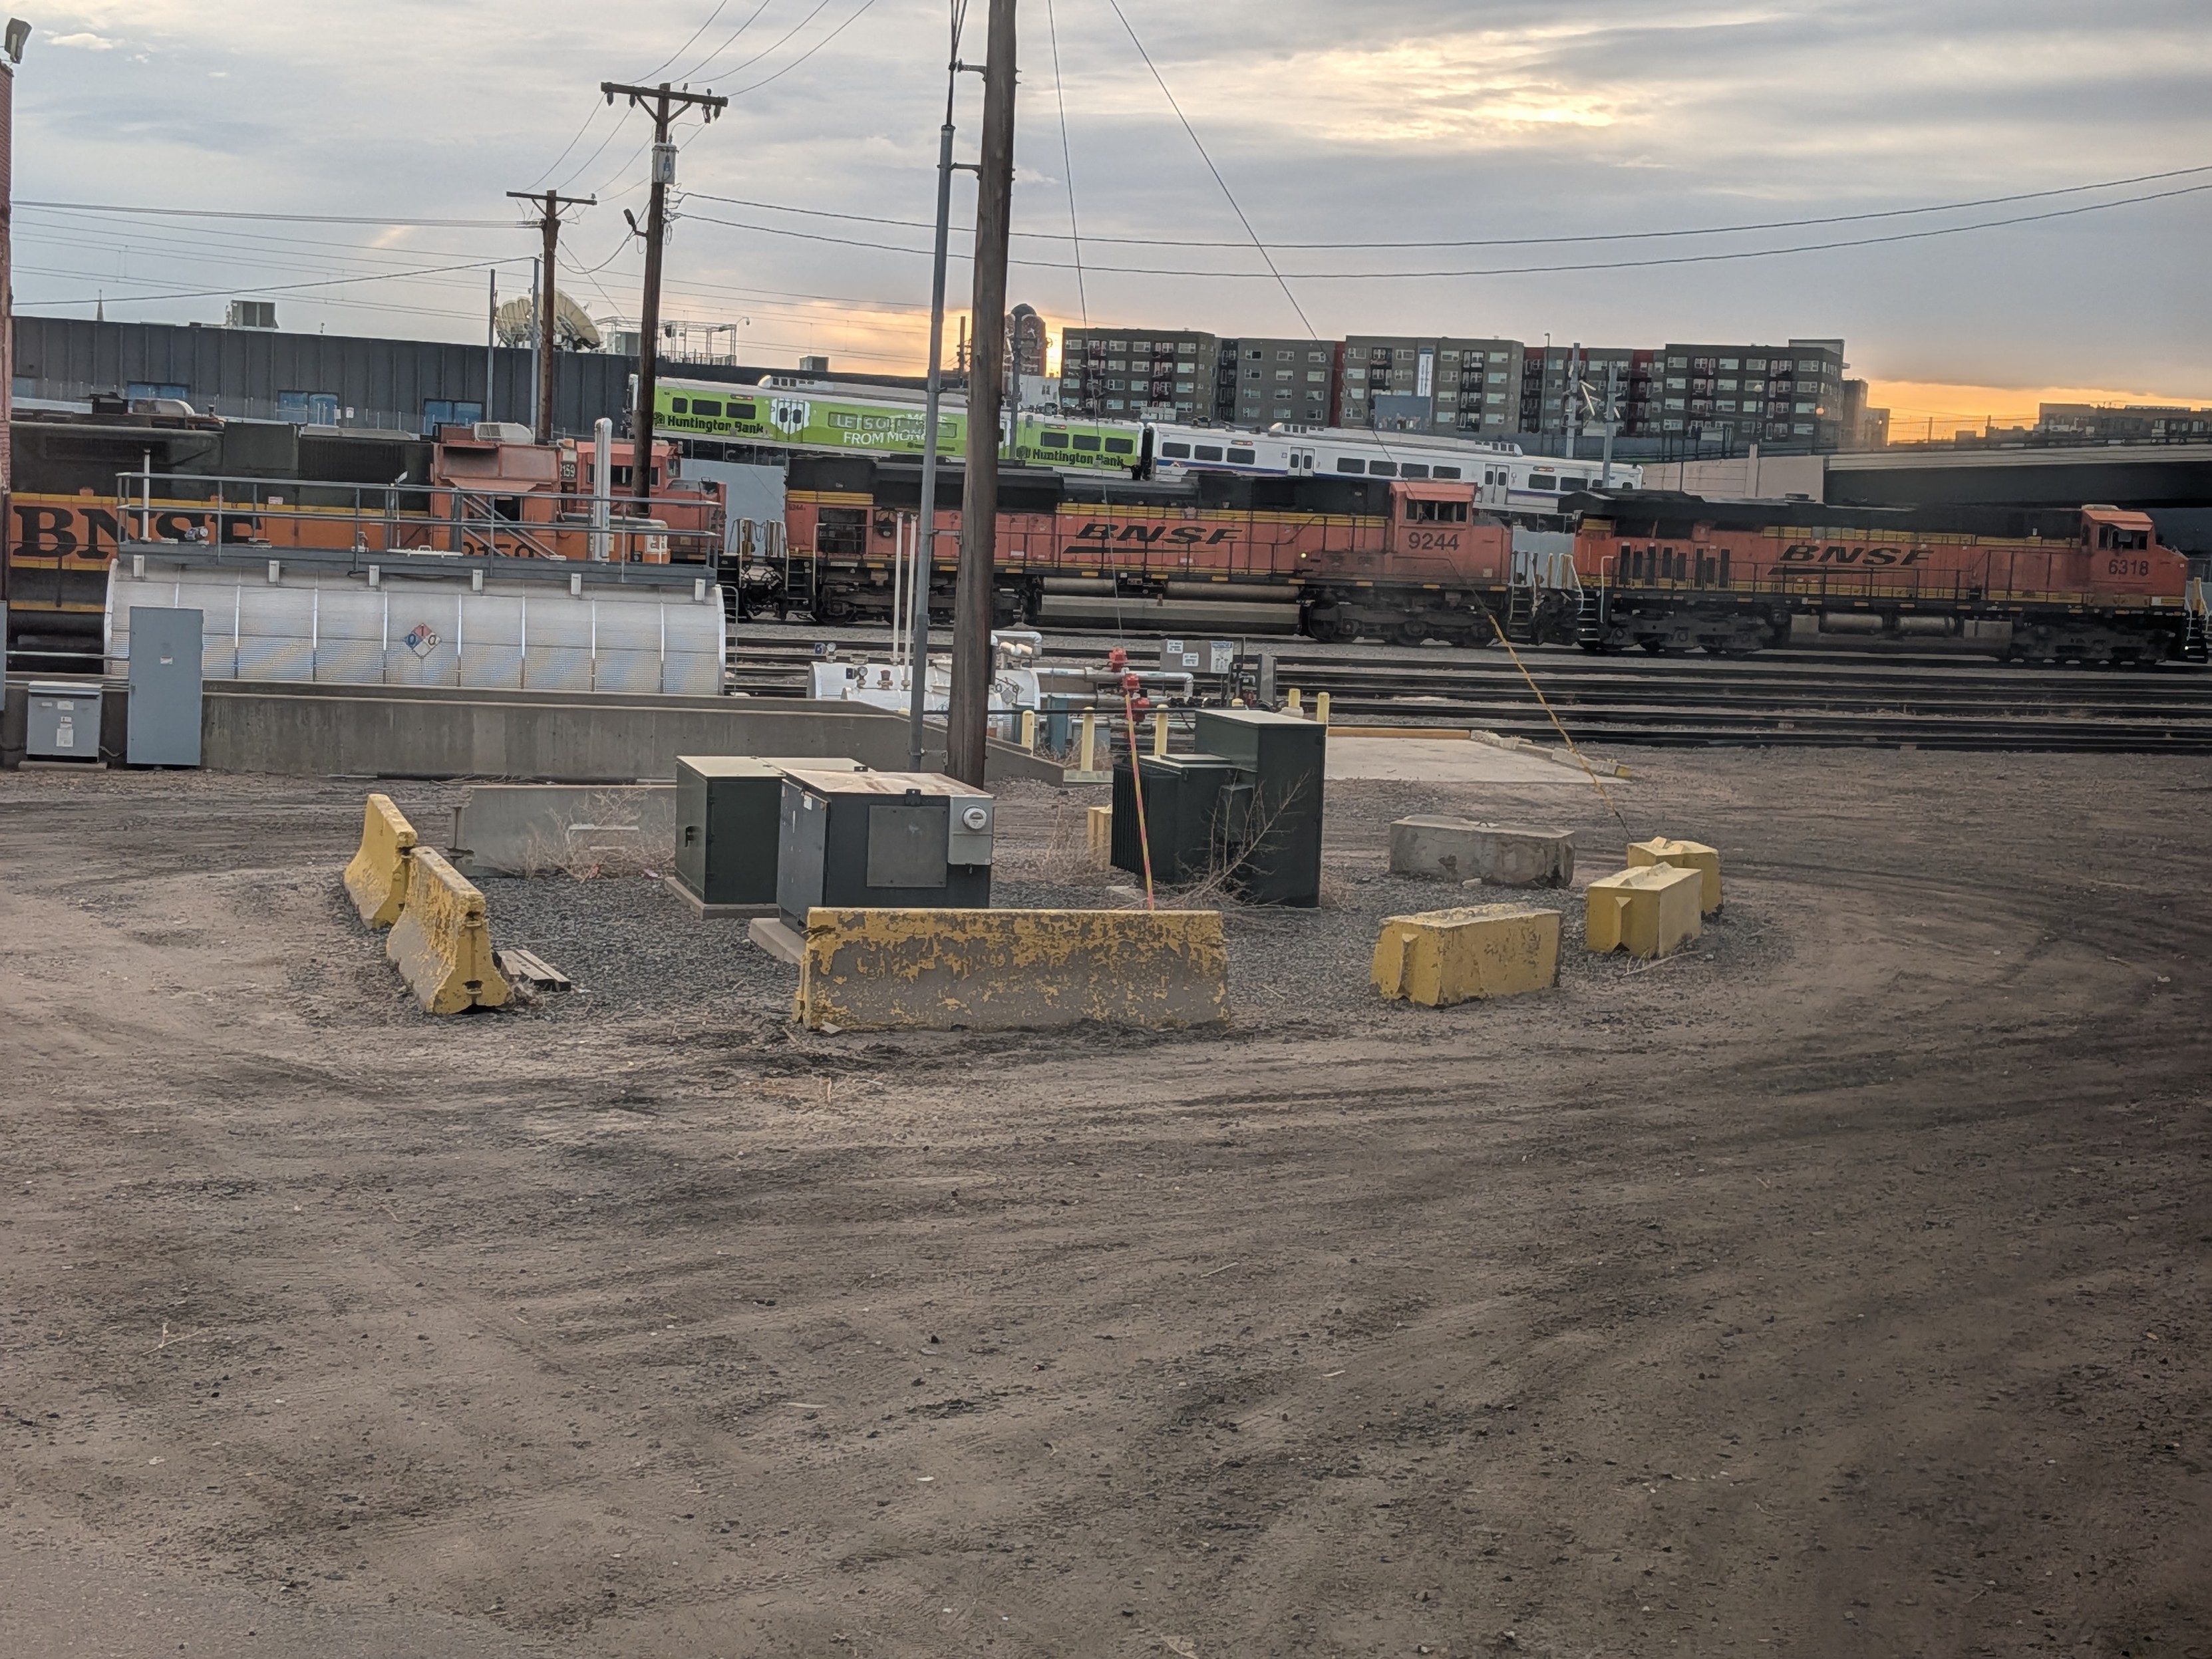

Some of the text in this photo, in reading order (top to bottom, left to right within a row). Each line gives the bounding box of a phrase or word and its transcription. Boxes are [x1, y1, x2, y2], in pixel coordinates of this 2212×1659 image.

[667, 414, 764, 434] Huntington Bank
[843, 431, 884, 445] FROM
[1032, 448, 1094, 465] Huntington
[1075, 523, 1243, 544] BNSF
[1408, 531, 1460, 551] 9244
[1779, 545, 1935, 565] BNSF
[2108, 559, 2149, 577] 6318
